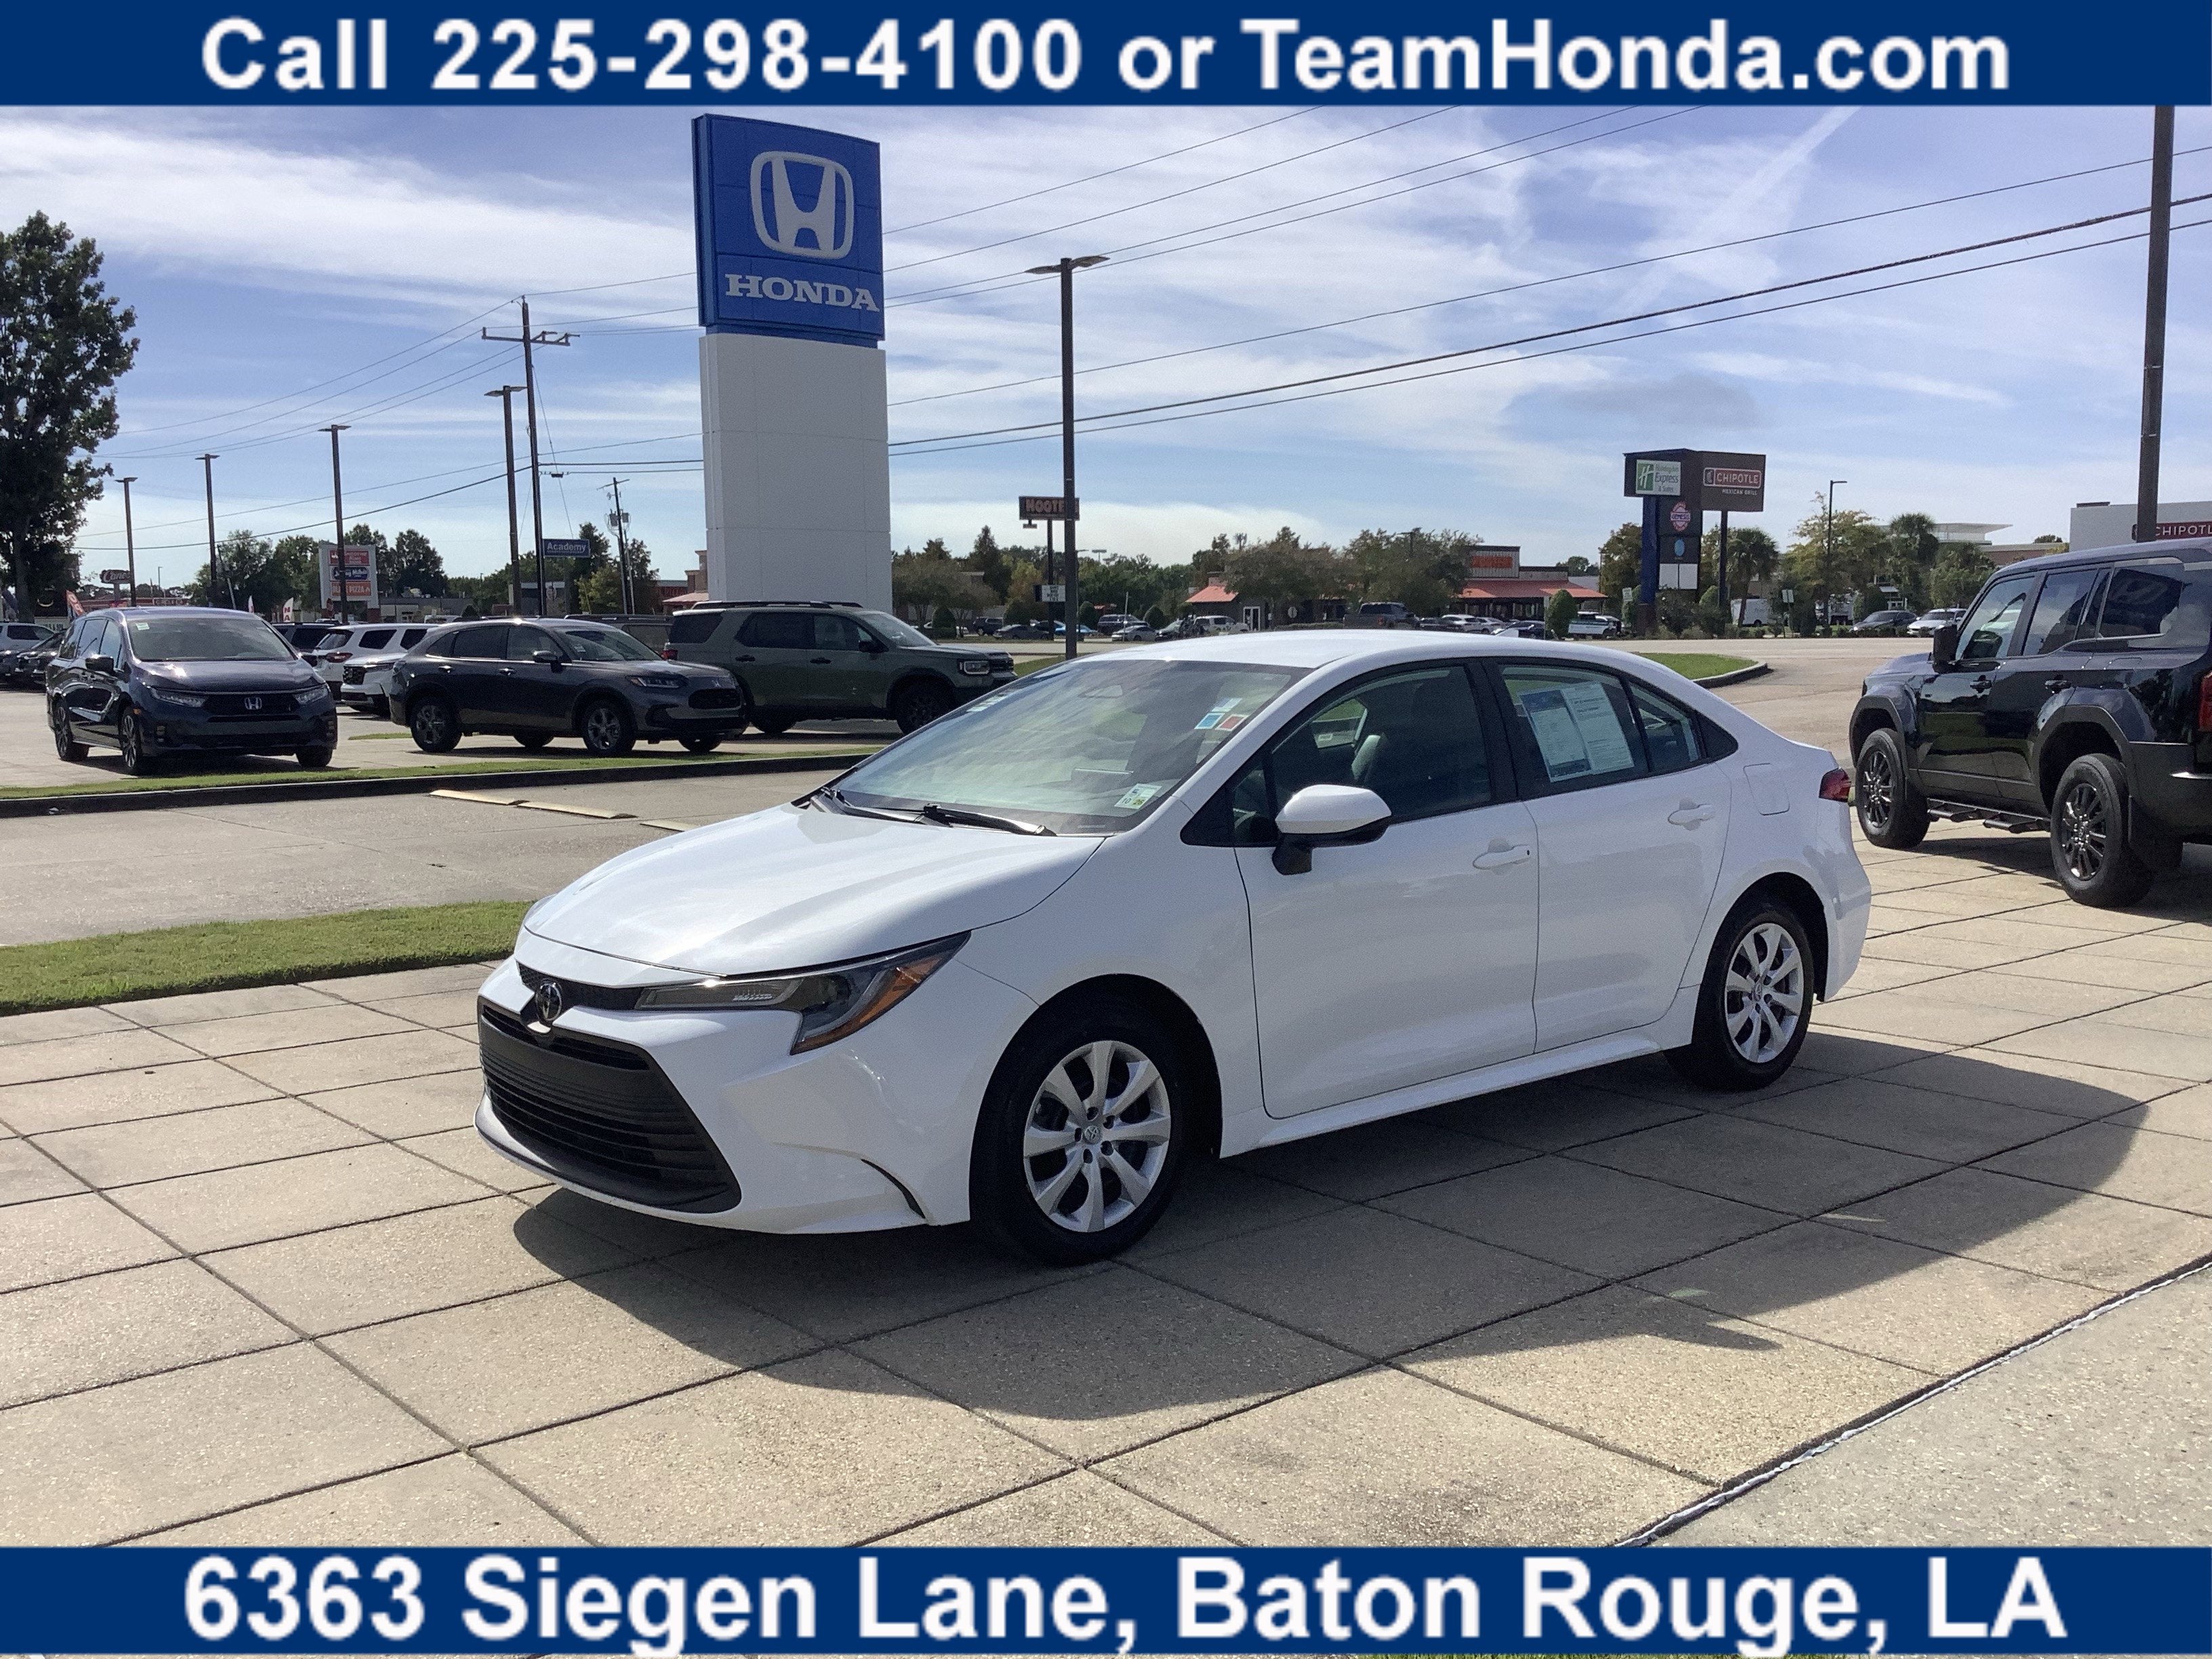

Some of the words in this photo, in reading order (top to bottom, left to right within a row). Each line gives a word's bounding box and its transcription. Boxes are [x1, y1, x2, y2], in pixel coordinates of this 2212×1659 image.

[724, 274, 880, 312] HONDA
[1655, 472, 1679, 485] Express
[1717, 473, 1759, 484] CHIPOTLE
[547, 542, 586, 553] Academy
